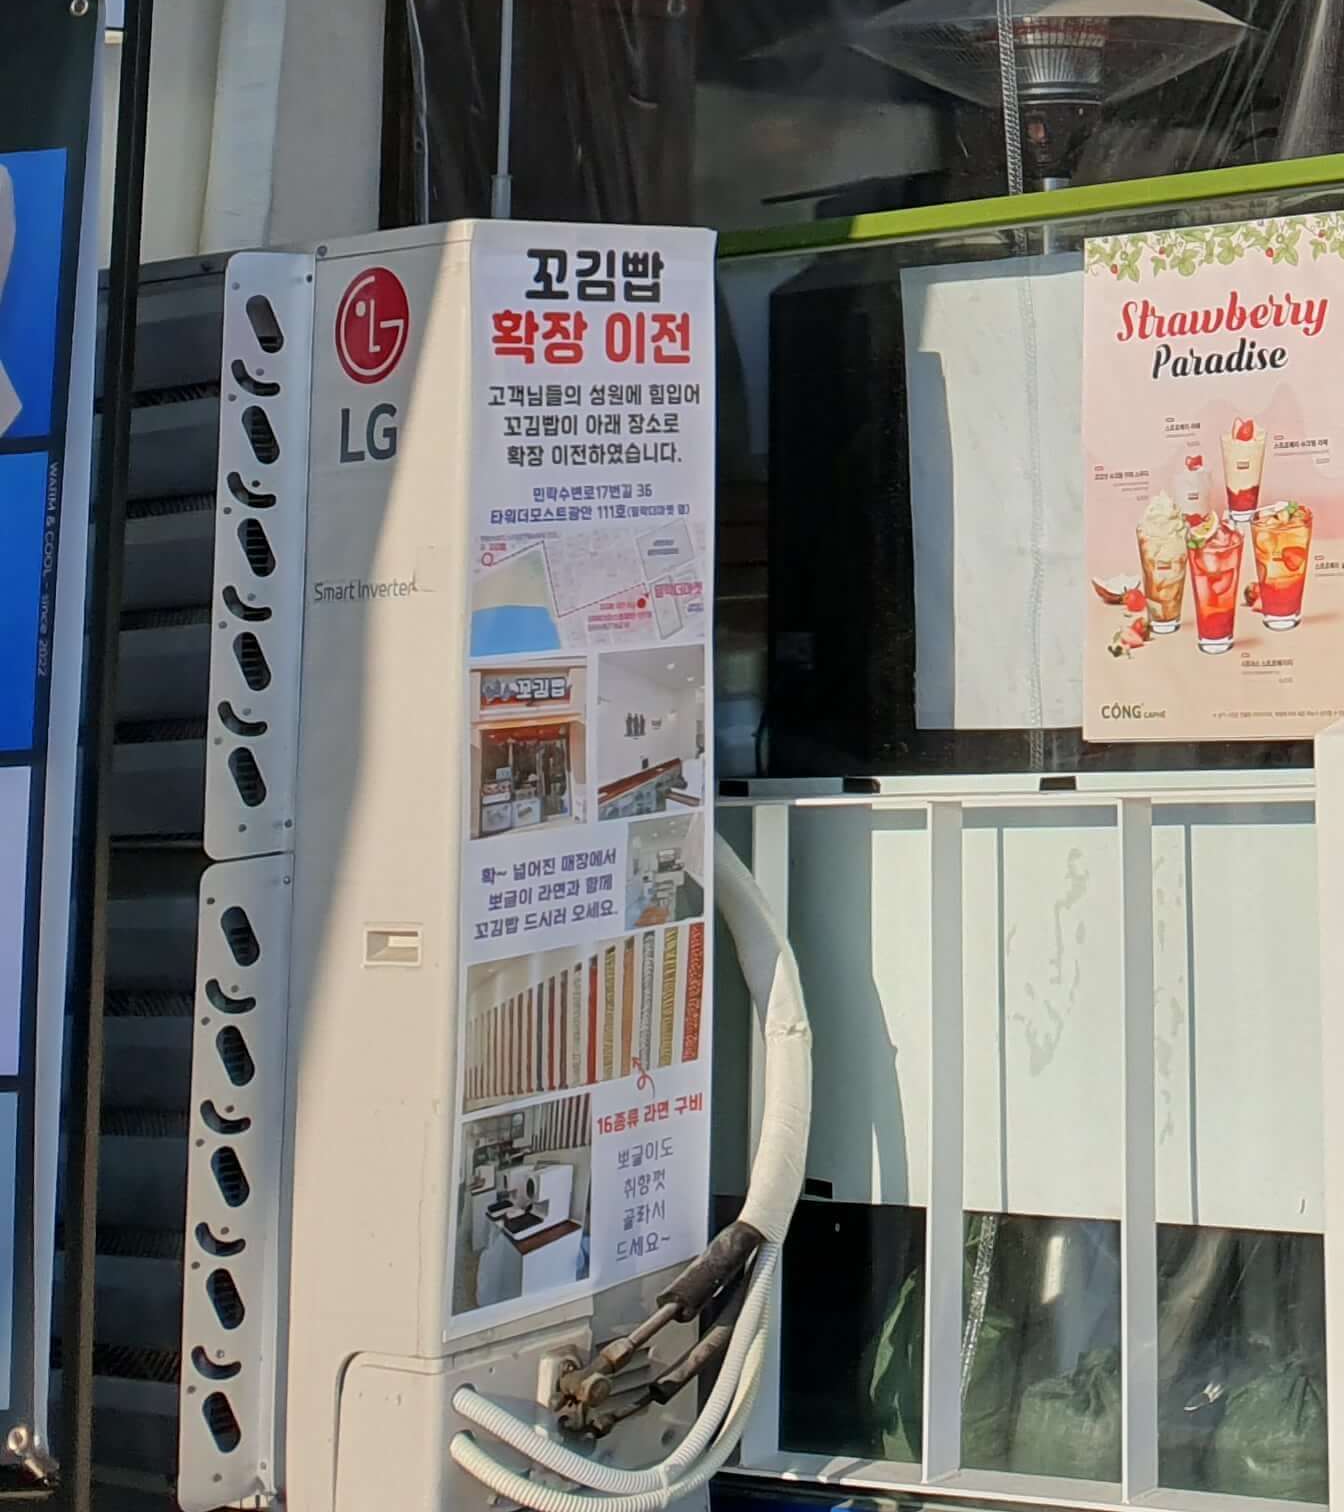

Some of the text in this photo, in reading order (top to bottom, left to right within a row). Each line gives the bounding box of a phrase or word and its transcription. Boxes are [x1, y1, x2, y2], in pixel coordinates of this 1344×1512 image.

[1116, 290, 1329, 341] Strawberry
[491, 309, 691, 364] 확장 이전
[1152, 337, 1289, 379] Paradise
[488, 383, 701, 407] 고객님들의 성원에 힘입어
[339, 403, 398, 463] LG
[586, 413, 621, 435] 아래
[628, 412, 680, 435] 장소로
[506, 442, 682, 467] 확장 이전하였습니다.
[490, 504, 593, 525] 타워더모스트광안
[43, 531, 55, 575] COOL
[313, 571, 418, 602] Smart Inverter
[40, 592, 50, 635] since
[36, 639, 49, 678] 2022
[561, 847, 617, 874] 매장에서
[488, 873, 614, 912] 뽀글이 라면과 함께
[524, 906, 567, 931] 드시러
[597, 1092, 703, 1135] 16종류 라면 구비
[617, 1137, 674, 1170] 뽀글이도
